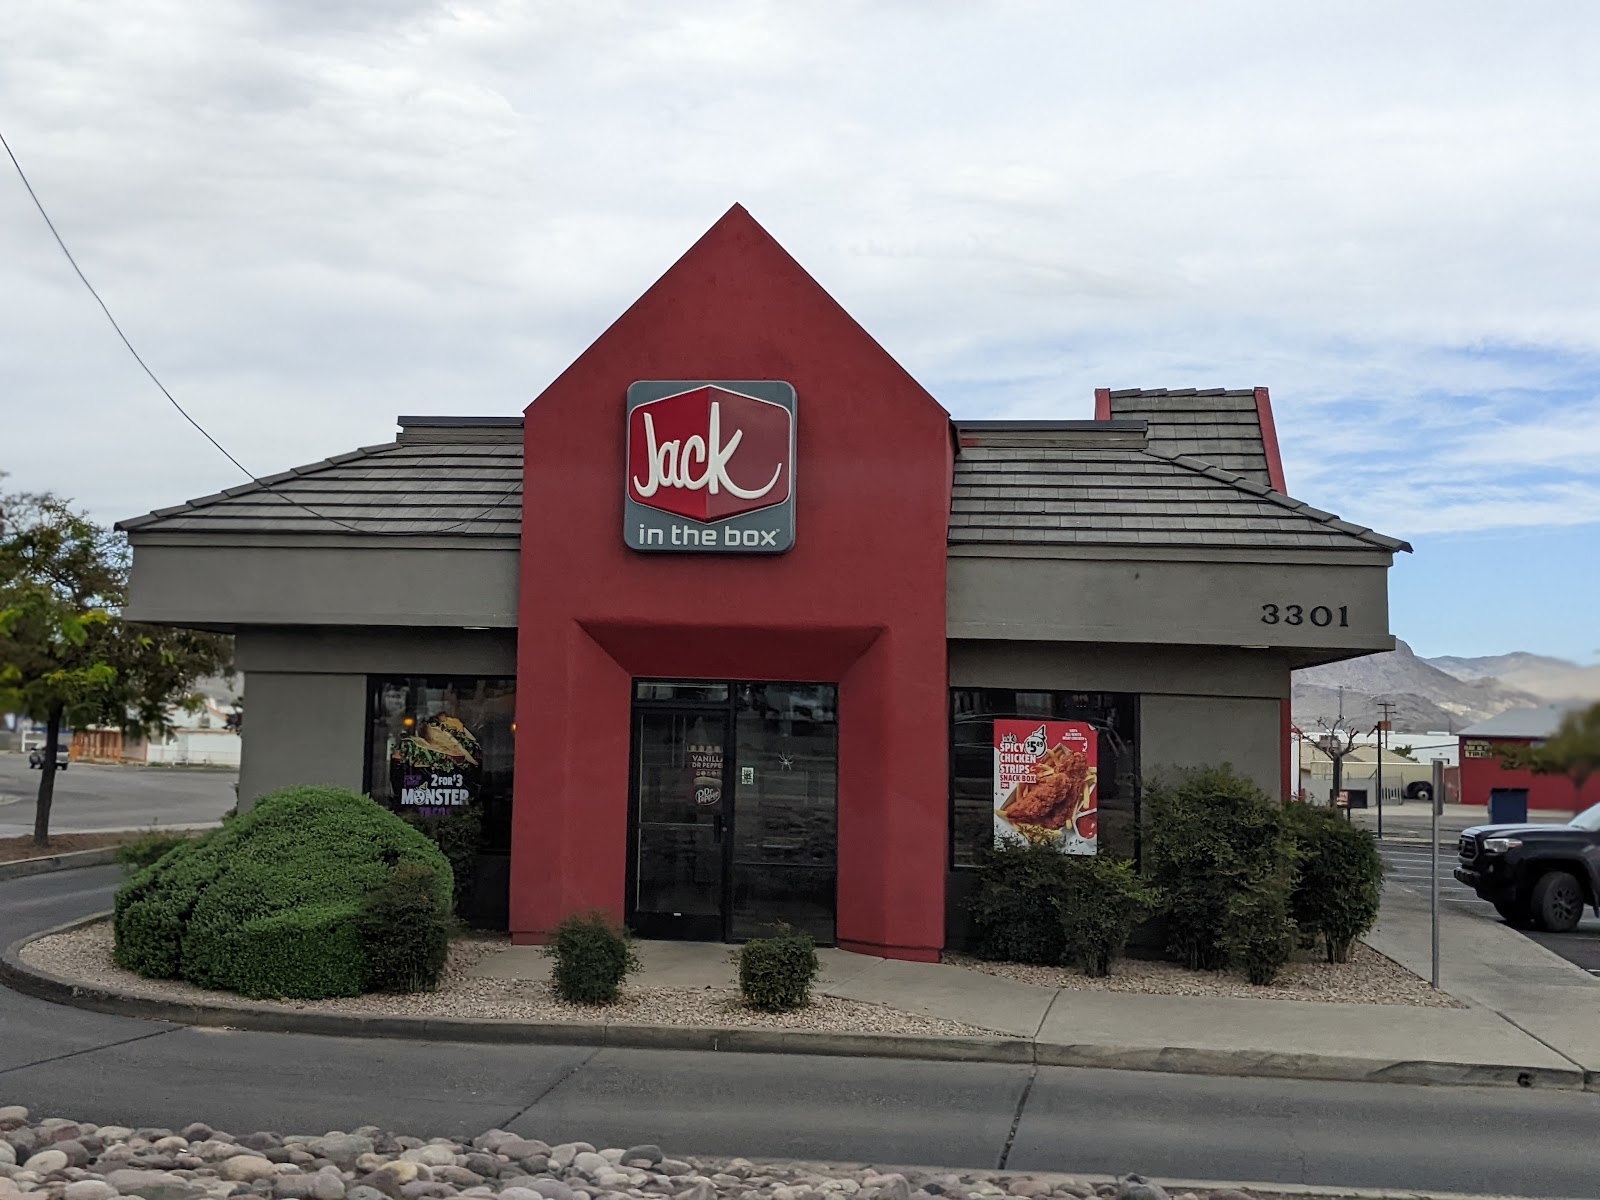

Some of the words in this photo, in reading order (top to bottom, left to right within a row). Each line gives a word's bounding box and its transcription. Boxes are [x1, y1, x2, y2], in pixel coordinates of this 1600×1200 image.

[633, 401, 782, 500] Jack
[639, 523, 664, 545] in
[671, 524, 717, 546] the
[724, 525, 777, 547] box
[1261, 603, 1349, 627] 3301
[999, 742, 1025, 753] SPICY
[999, 753, 1037, 764] CHICKEN
[999, 764, 1030, 775] STRIPS
[431, 774, 438, 787] 2
[438, 776, 453, 786] FOR
[1000, 774, 1020, 782] SNACK
[1021, 775, 1036, 783] BOX
[401, 788, 470, 806] MONSTER
